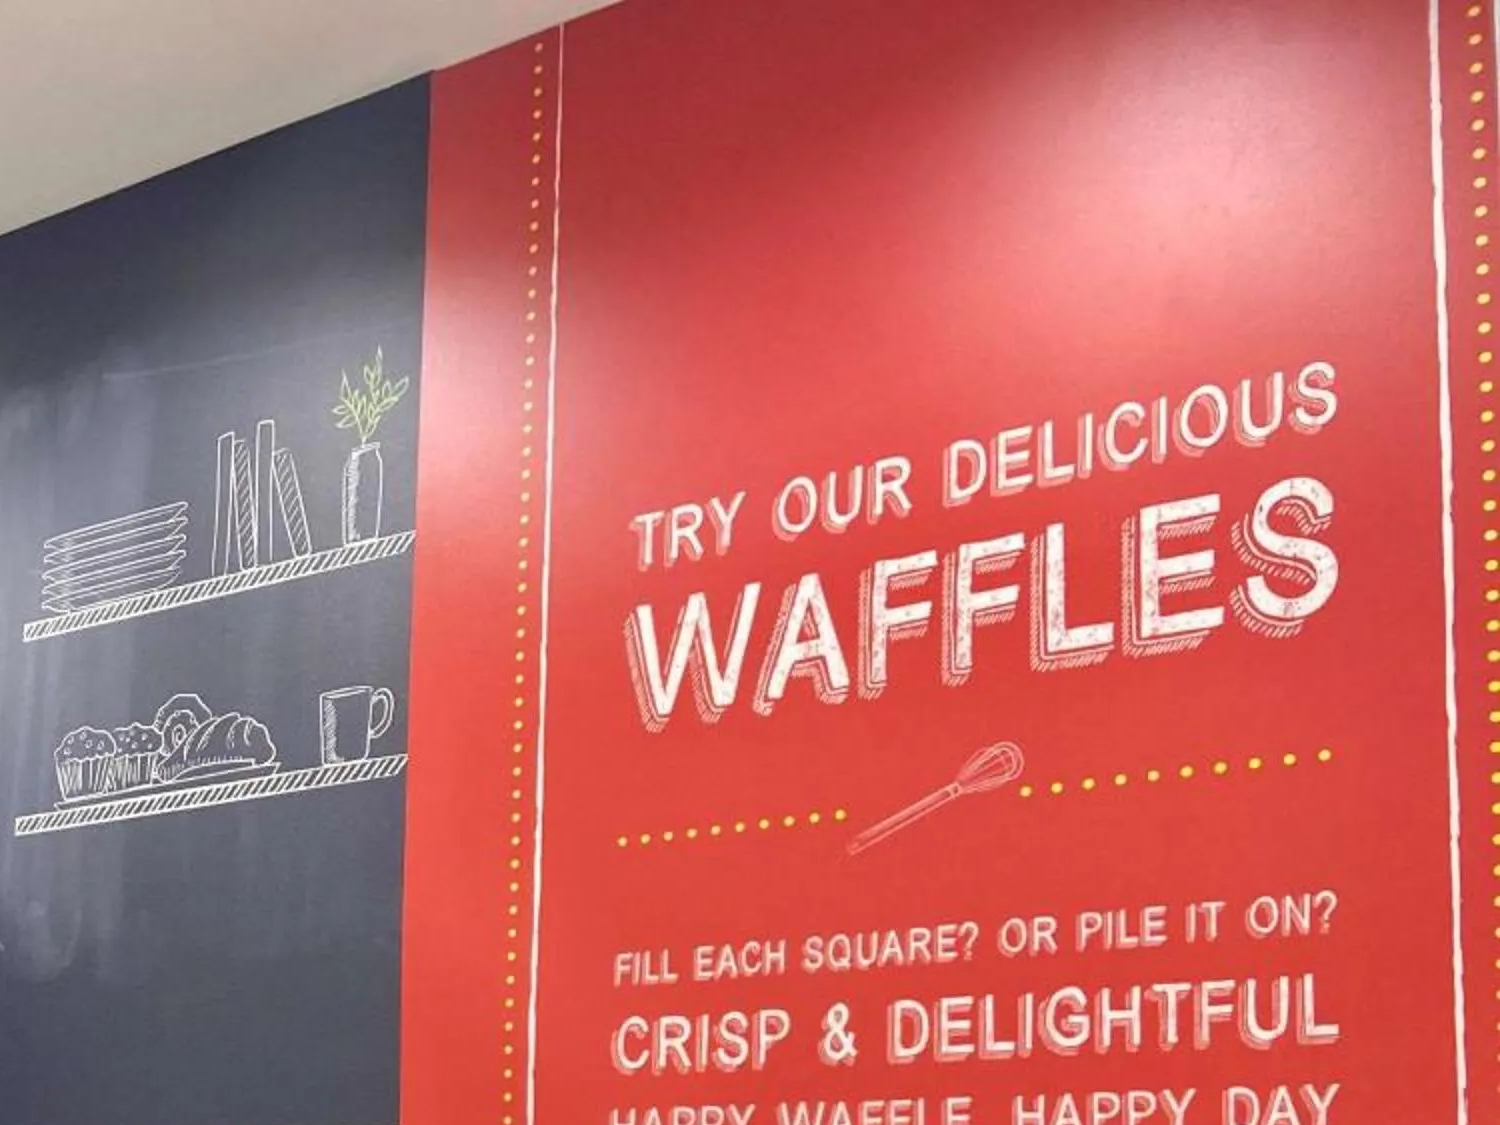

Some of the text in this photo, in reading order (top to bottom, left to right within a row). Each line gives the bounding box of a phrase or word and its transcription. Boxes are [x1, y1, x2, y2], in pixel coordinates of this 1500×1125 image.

[632, 361, 1338, 570] TRY OUR DELICIOUS
[624, 477, 1340, 734] WAFFLES
[614, 890, 1337, 987] FILL EACH SQUARE? OR PILE IT ON?
[610, 973, 1339, 1075] CRISP & DELIGHTFUL
